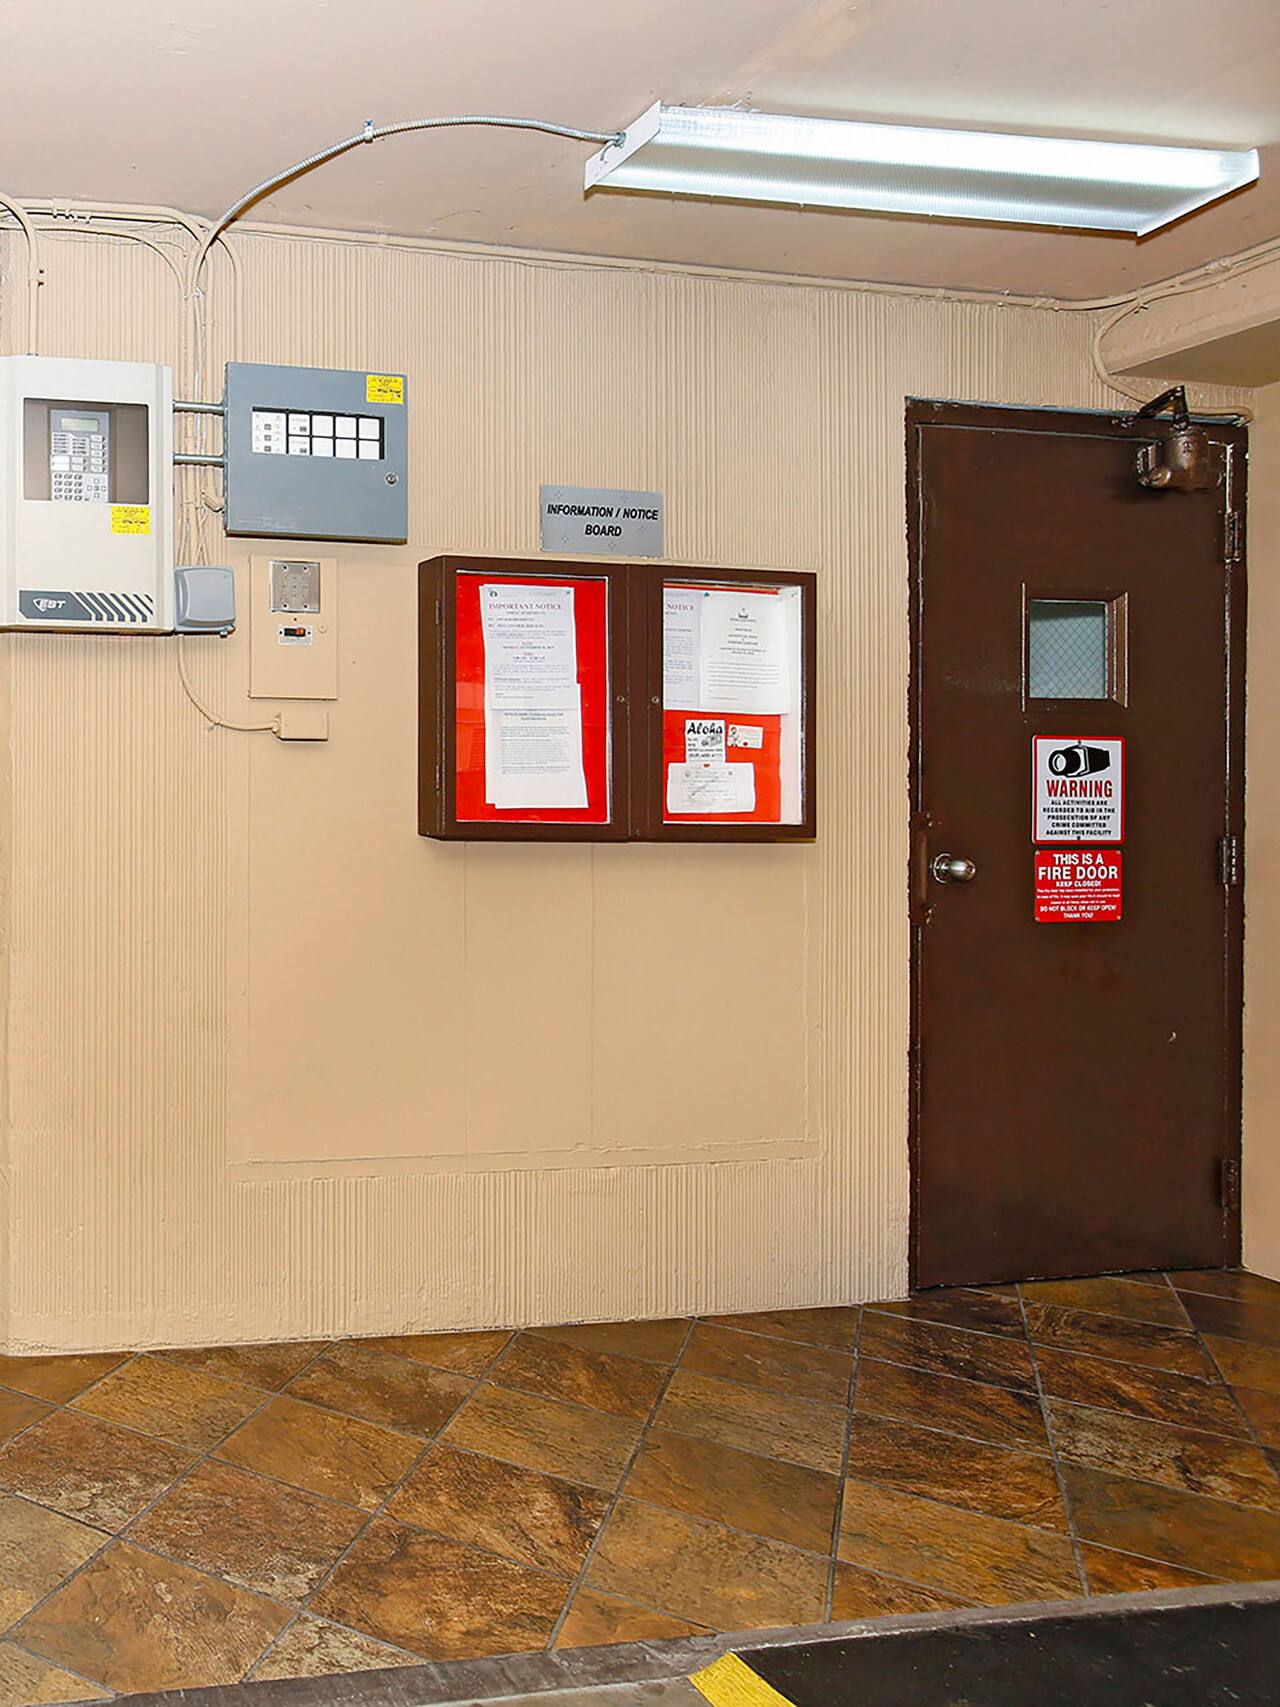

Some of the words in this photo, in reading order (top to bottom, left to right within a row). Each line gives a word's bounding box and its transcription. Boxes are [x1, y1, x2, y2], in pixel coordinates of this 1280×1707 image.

[547, 504, 614, 517] INFORMATION
[615, 508, 621, 518] /
[623, 508, 658, 520] NOTICE
[585, 524, 622, 536] BOARD
[687, 722, 722, 735] Aloha
[1046, 780, 1112, 798] WARNING
[1053, 854, 1079, 865] THIS
[1082, 854, 1093, 865] IS
[1095, 853, 1104, 864] A
[1038, 866, 1071, 880] FIRE
[1076, 866, 1118, 879] DOOR
